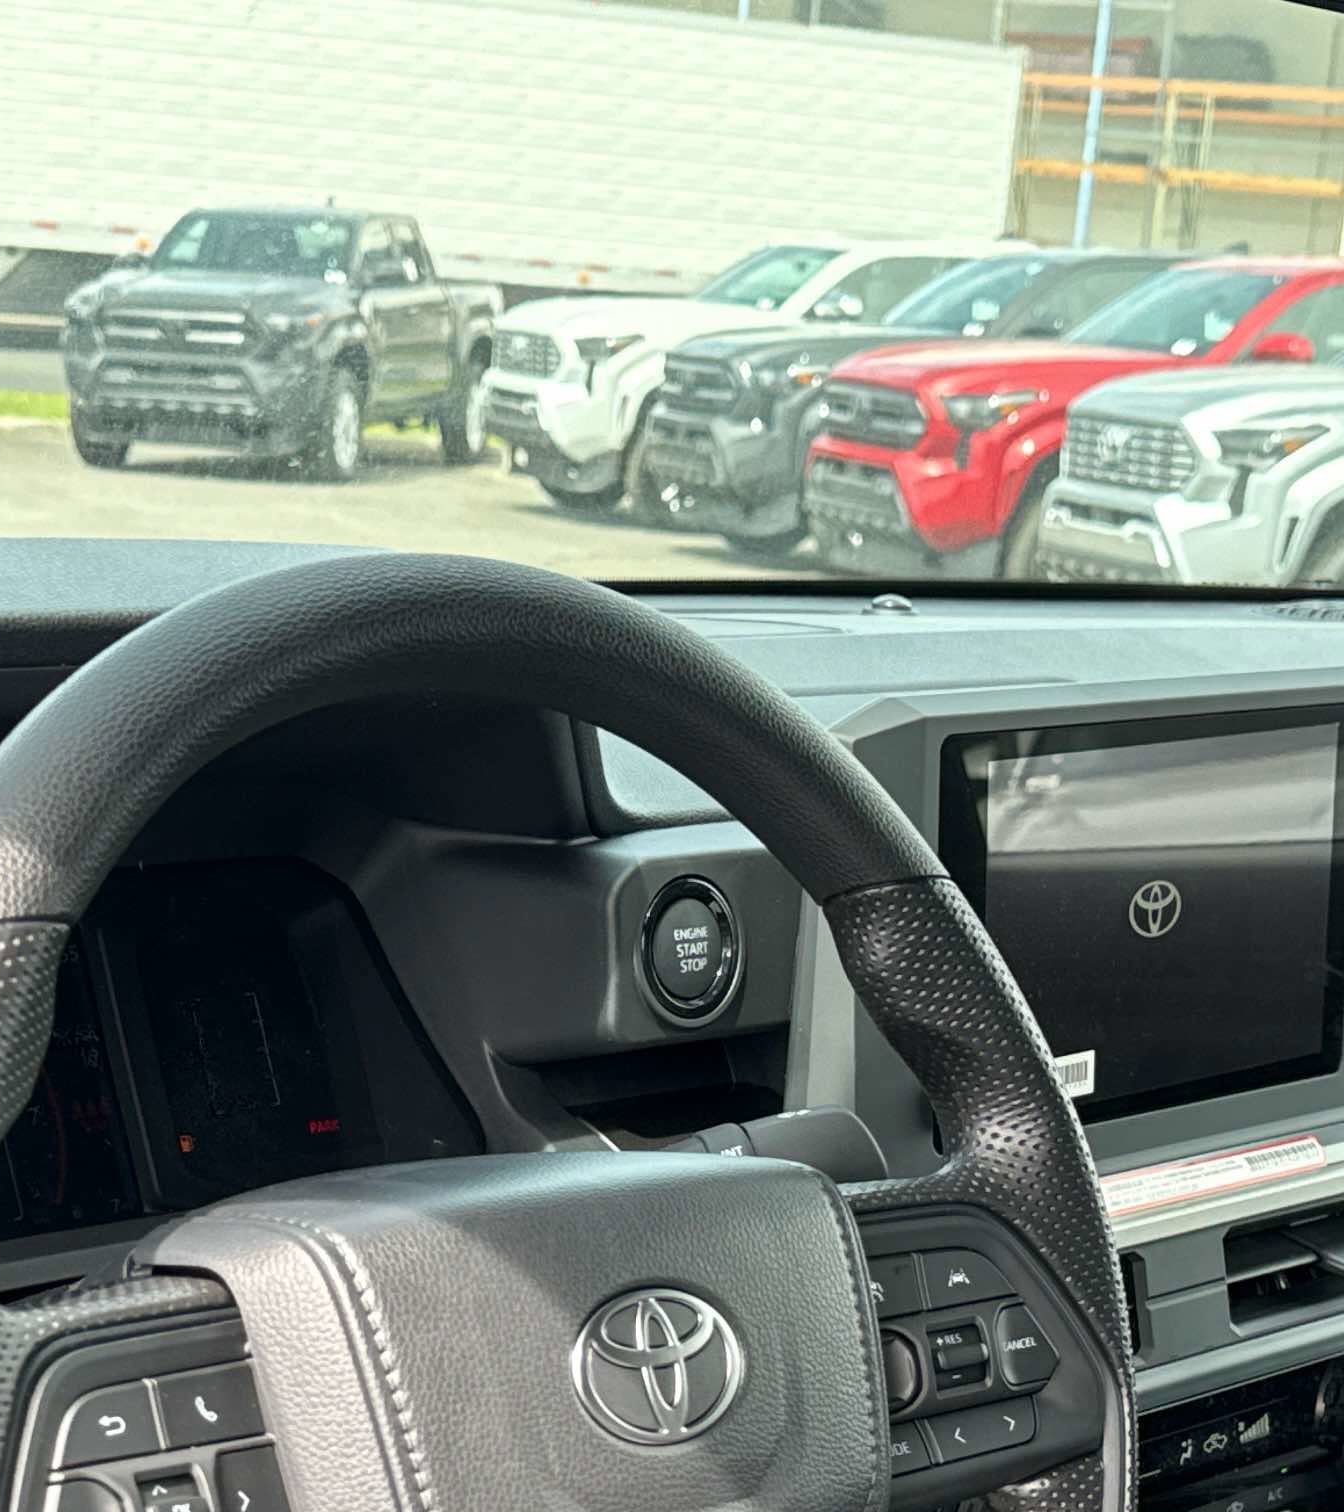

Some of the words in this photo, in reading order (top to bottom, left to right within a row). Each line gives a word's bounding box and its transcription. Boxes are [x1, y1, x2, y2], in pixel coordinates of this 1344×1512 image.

[673, 926, 709, 941] ENGINE
[676, 941, 709, 958] START
[679, 957, 708, 974] STOP
[1004, 1337, 1037, 1352] CANCEL
